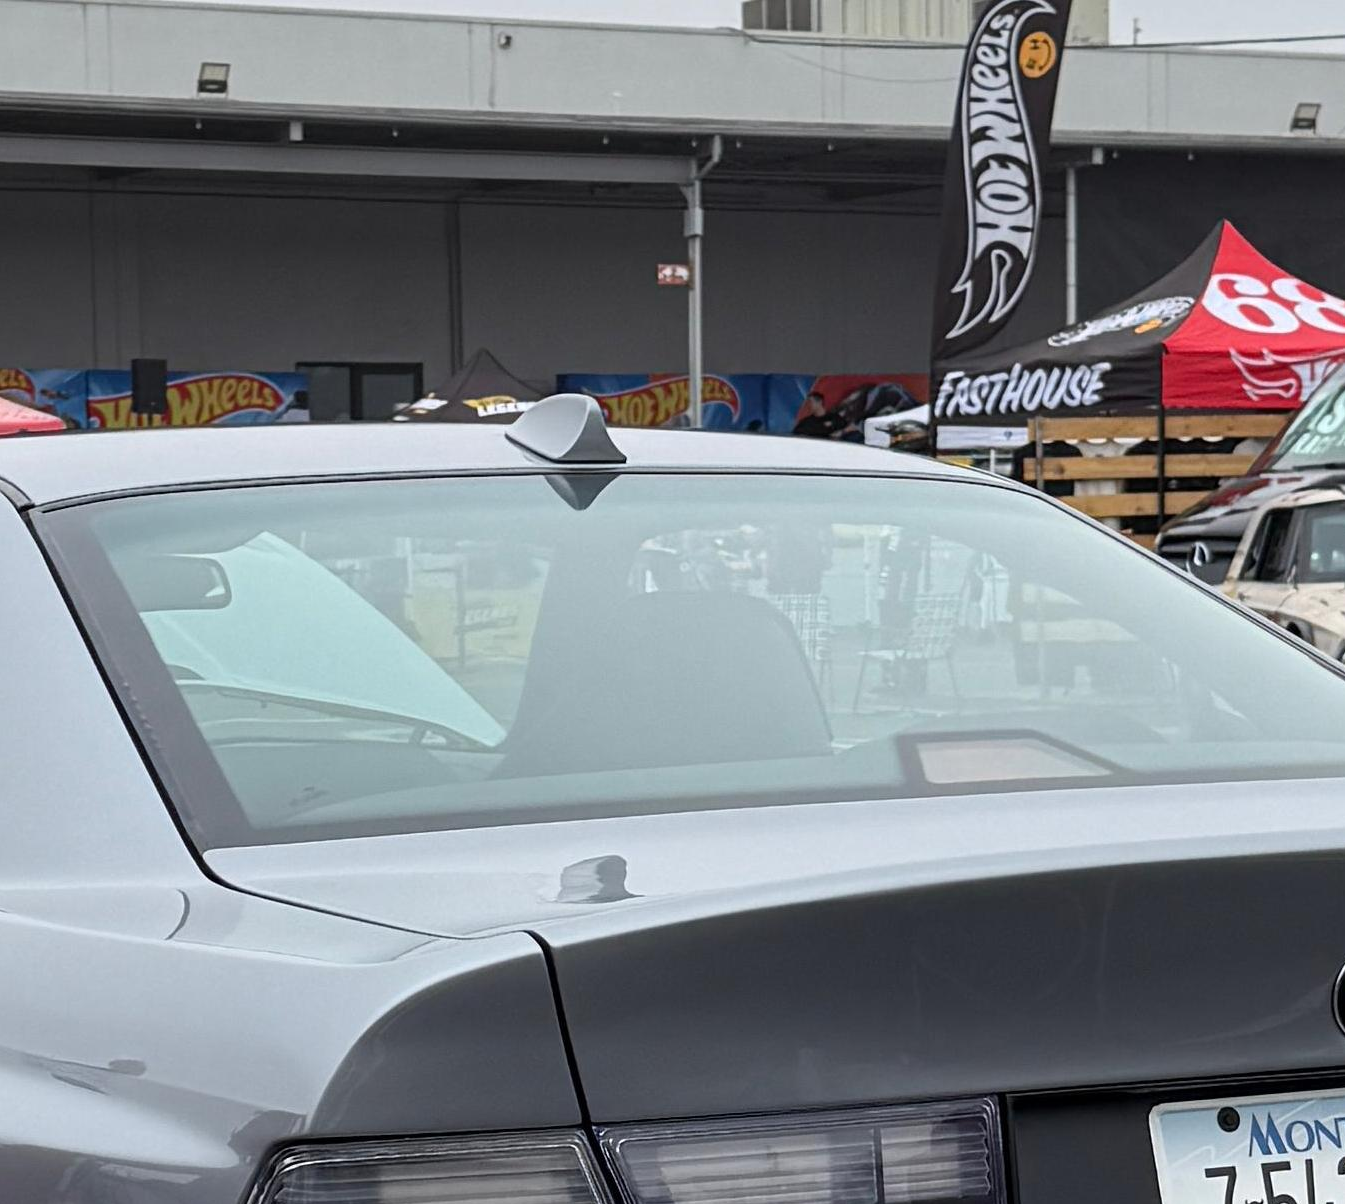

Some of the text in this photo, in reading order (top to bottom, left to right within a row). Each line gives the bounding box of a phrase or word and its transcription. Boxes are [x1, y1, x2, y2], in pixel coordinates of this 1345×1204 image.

[974, 157, 1034, 262] HOT
[651, 377, 732, 425] WHeLS
[933, 361, 1112, 419] FASTHOUSE
